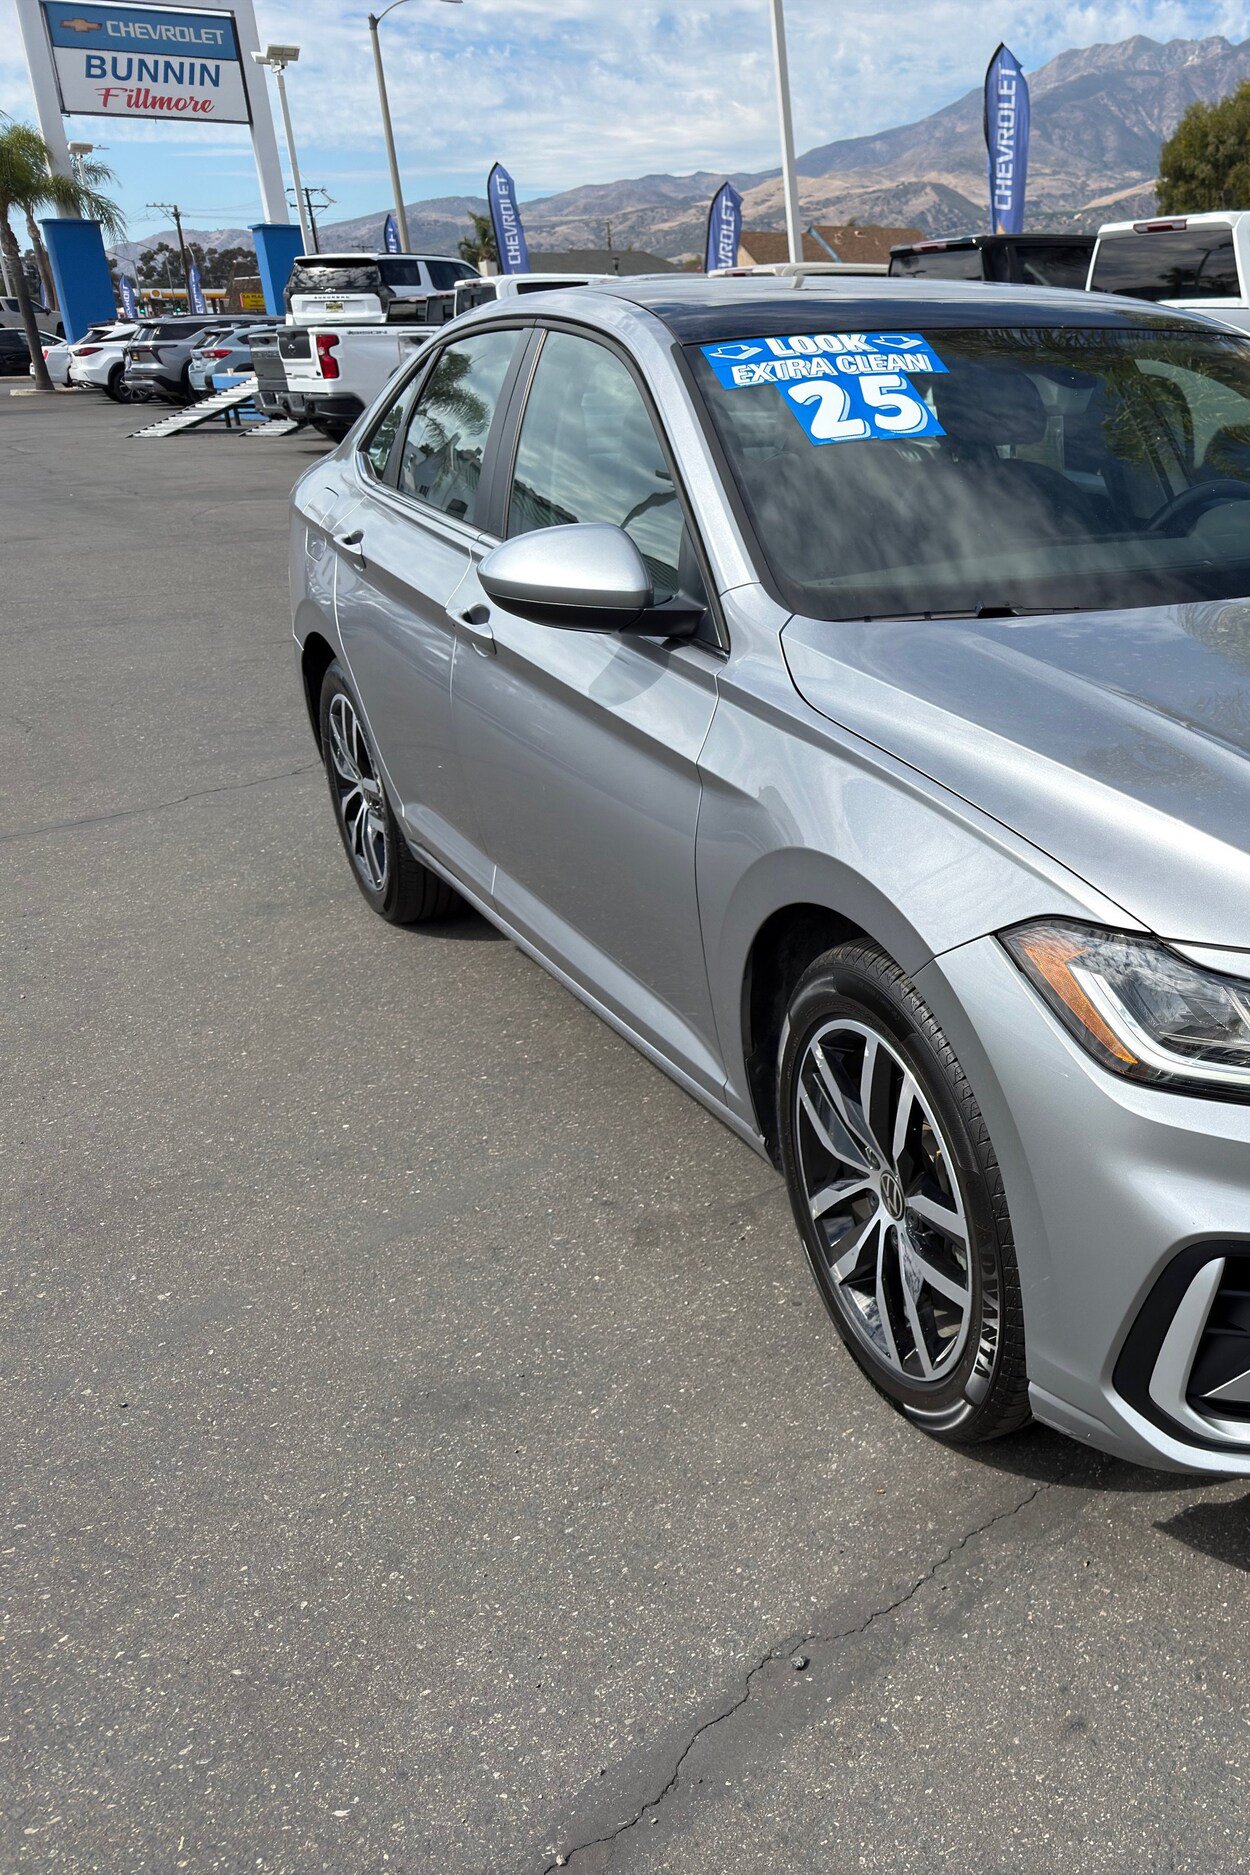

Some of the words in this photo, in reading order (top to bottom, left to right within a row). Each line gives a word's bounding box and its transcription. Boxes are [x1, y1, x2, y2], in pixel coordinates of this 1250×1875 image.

[106, 20, 224, 45] CHEVROLET
[85, 54, 221, 87] BUNNIN
[94, 87, 216, 114] Fillmore
[994, 63, 1017, 211] CHEVROLET
[765, 333, 877, 357] LOOK
[731, 357, 837, 386] EXTRA
[836, 353, 933, 374] CLEAN
[788, 374, 929, 441] 25
